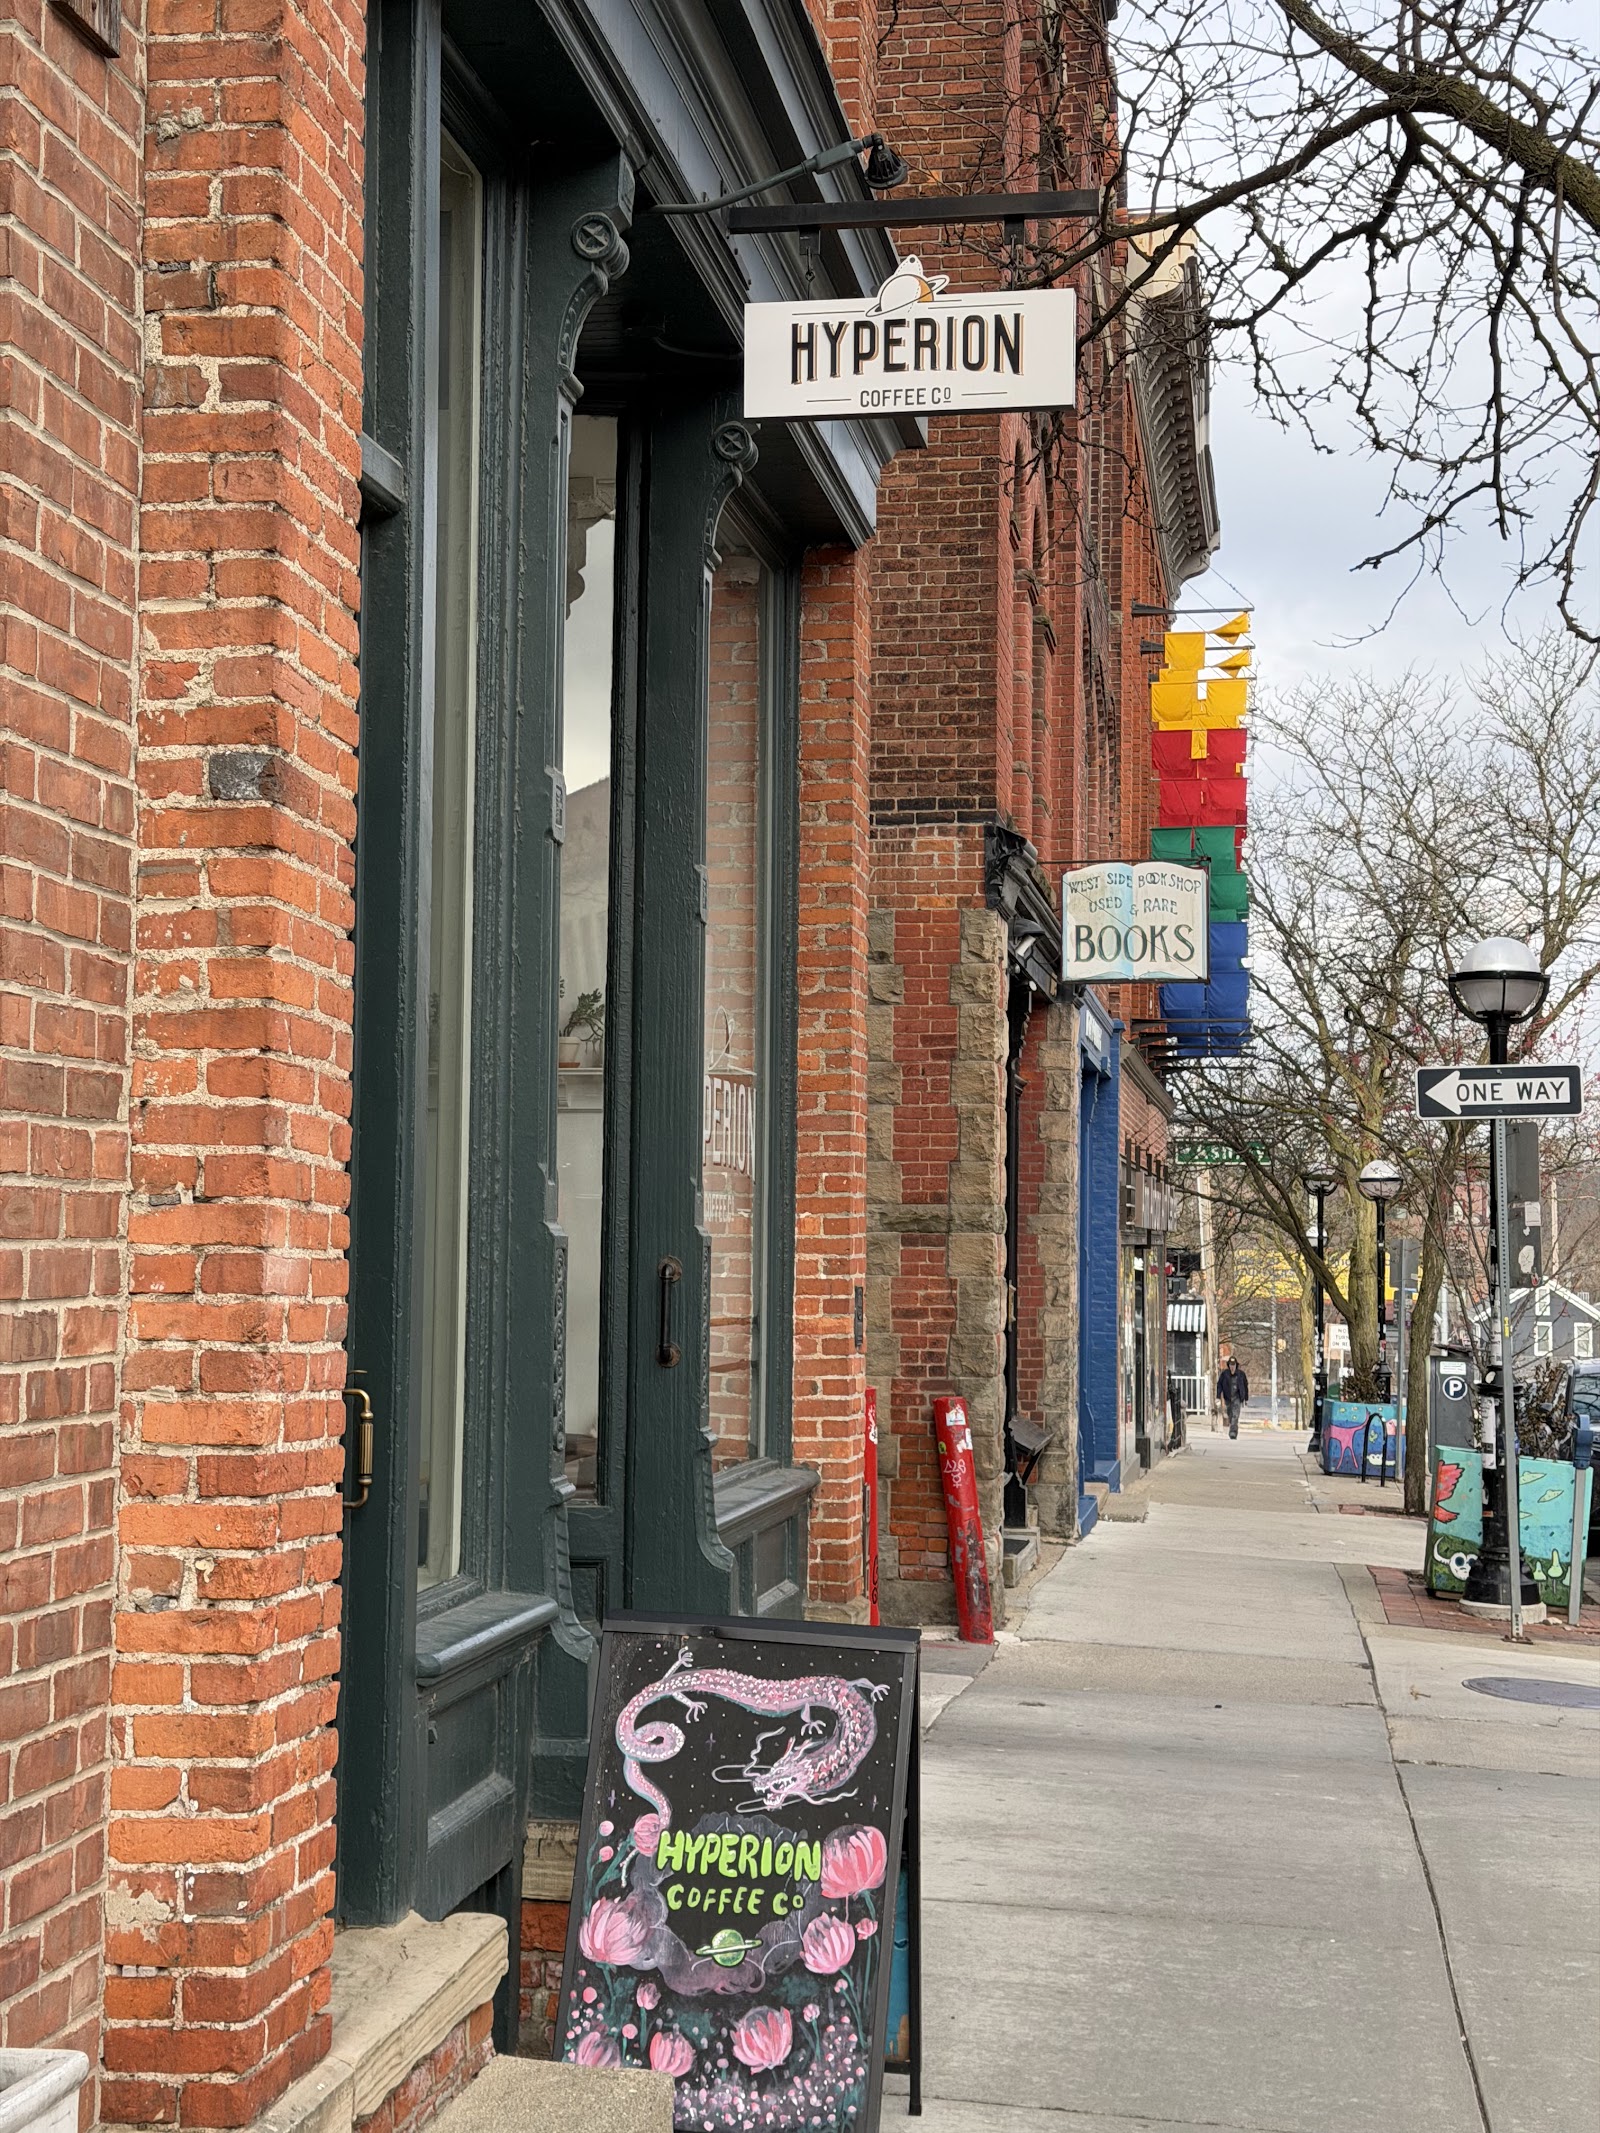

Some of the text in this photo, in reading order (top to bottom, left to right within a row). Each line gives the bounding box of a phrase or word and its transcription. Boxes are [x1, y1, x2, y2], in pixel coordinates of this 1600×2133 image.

[791, 313, 1025, 384] HYPERION
[860, 388, 926, 407] COFFEE
[1069, 876, 1100, 893] WEST
[1107, 873, 1132, 888] SIDE
[1089, 897, 1178, 916] USED & RARE
[1074, 924, 1195, 962] BOOKS
[1456, 1081, 1565, 1102] ONE WAY
[703, 1076, 756, 1184] PERION
[1449, 1380, 1462, 1396] P
[657, 1830, 822, 1881] HYPERION
[667, 1884, 765, 1915] COFFEE
